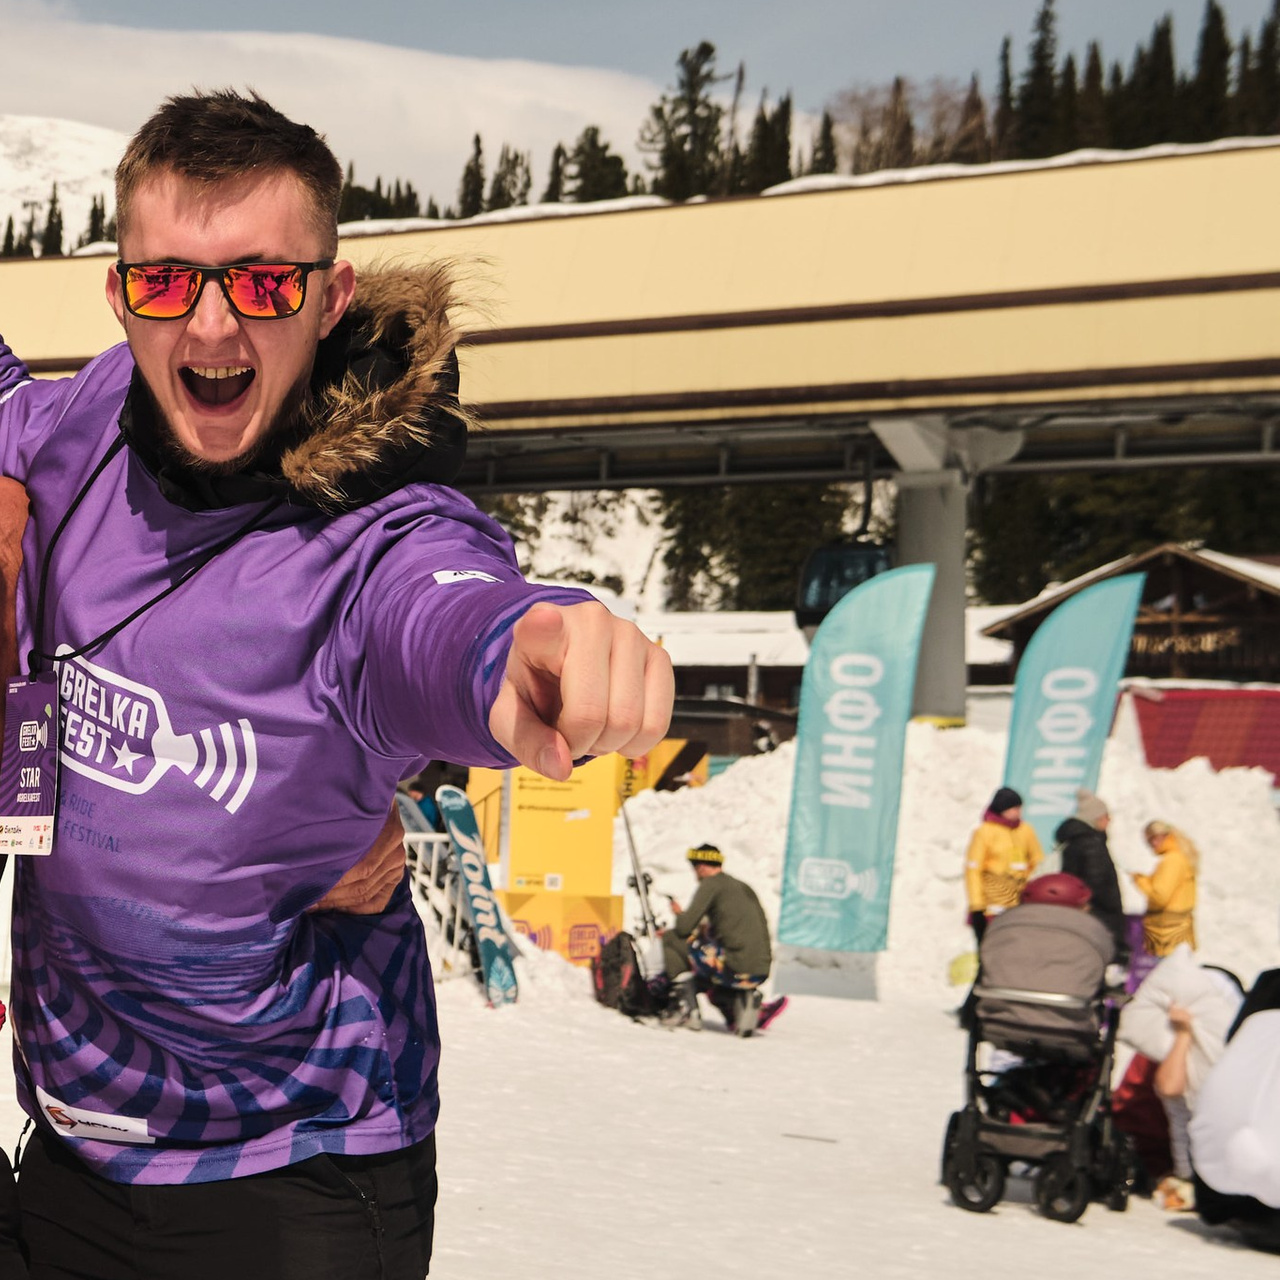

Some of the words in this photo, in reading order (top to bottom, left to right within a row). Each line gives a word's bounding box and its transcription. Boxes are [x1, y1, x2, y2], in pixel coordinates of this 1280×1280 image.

[60, 662, 149, 740] GRELKA
[820, 652, 884, 809] ИНФО
[1027, 666, 1096, 816] ИНФО
[20, 767, 40, 788] STAR
[70, 793, 97, 819] RIDE
[62, 820, 122, 853] FESTIVAL
